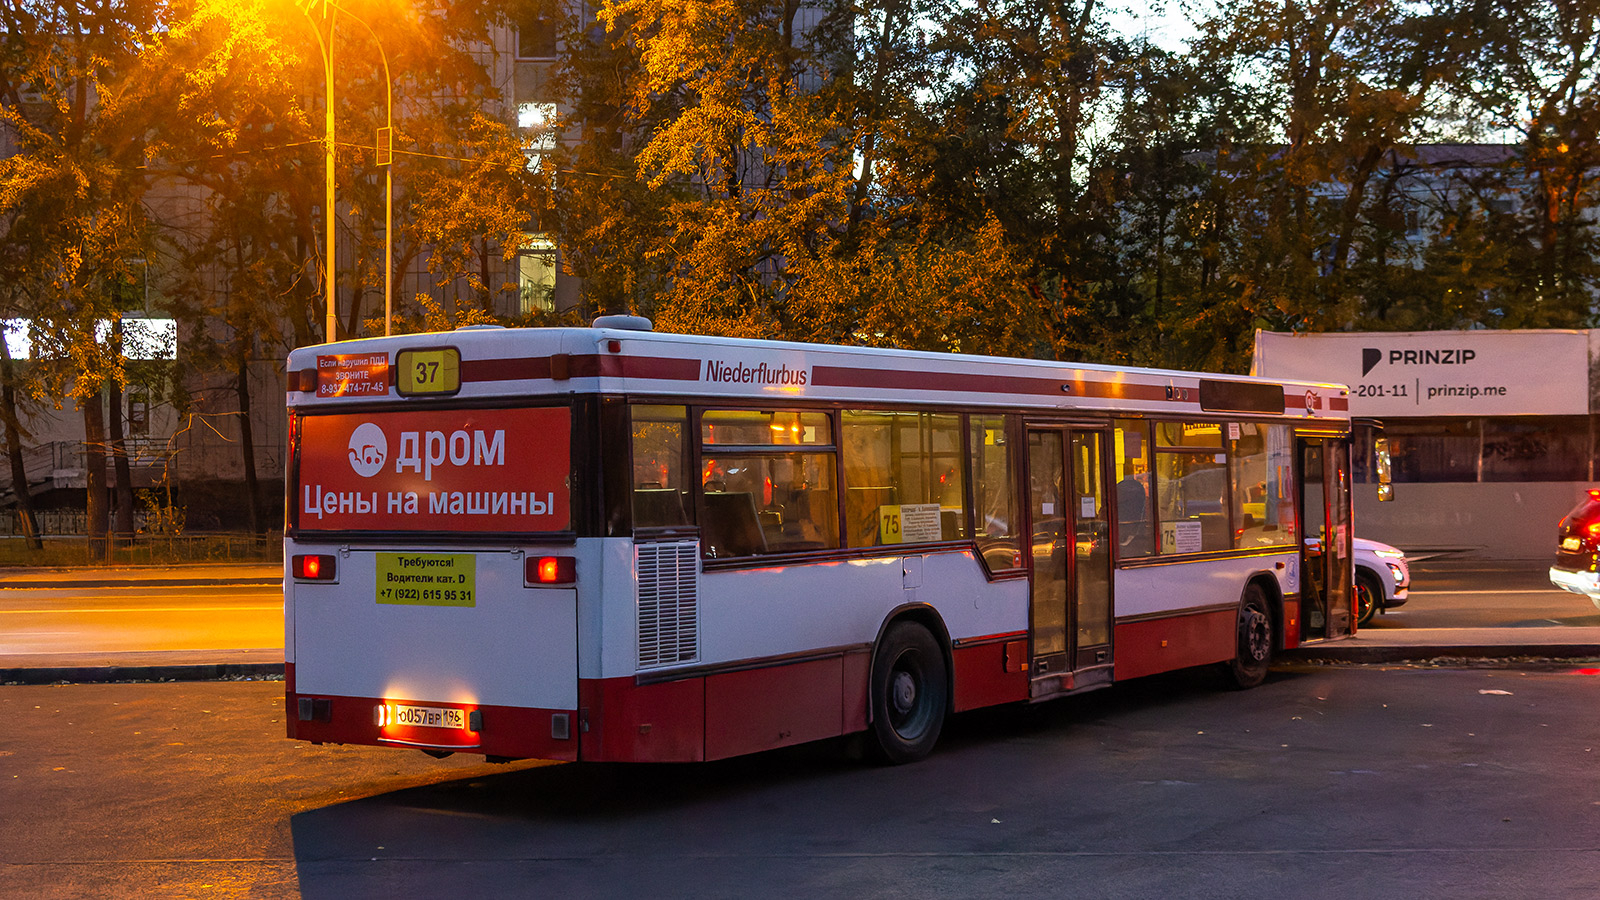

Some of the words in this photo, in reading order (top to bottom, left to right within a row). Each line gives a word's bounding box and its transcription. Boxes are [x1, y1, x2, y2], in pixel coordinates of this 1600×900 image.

[320, 359, 337, 368] Если
[338, 358, 368, 369] нарушил
[370, 356, 385, 366] ПДД
[1389, 350, 1476, 365] PRINZIP
[336, 370, 369, 380] ЗВОНИТЕ
[415, 361, 440, 384] 37
[706, 360, 808, 386] Niederflurbus
[1427, 384, 1507, 400] prinzip.me
[396, 430, 505, 481] дром
[304, 485, 378, 519] Цены
[387, 491, 418, 514] на
[428, 492, 554, 515] машины
[884, 514, 899, 534] 75
[1165, 530, 1175, 545] 75
[398, 557, 454, 568] Требуются!
[387, 572, 433, 584] Водители
[458, 574, 466, 584] D
[380, 588, 392, 598] +7
[395, 588, 420, 600] (922)
[423, 590, 441, 600] 615
[444, 590, 456, 600] 95
[460, 591, 472, 600] 31
